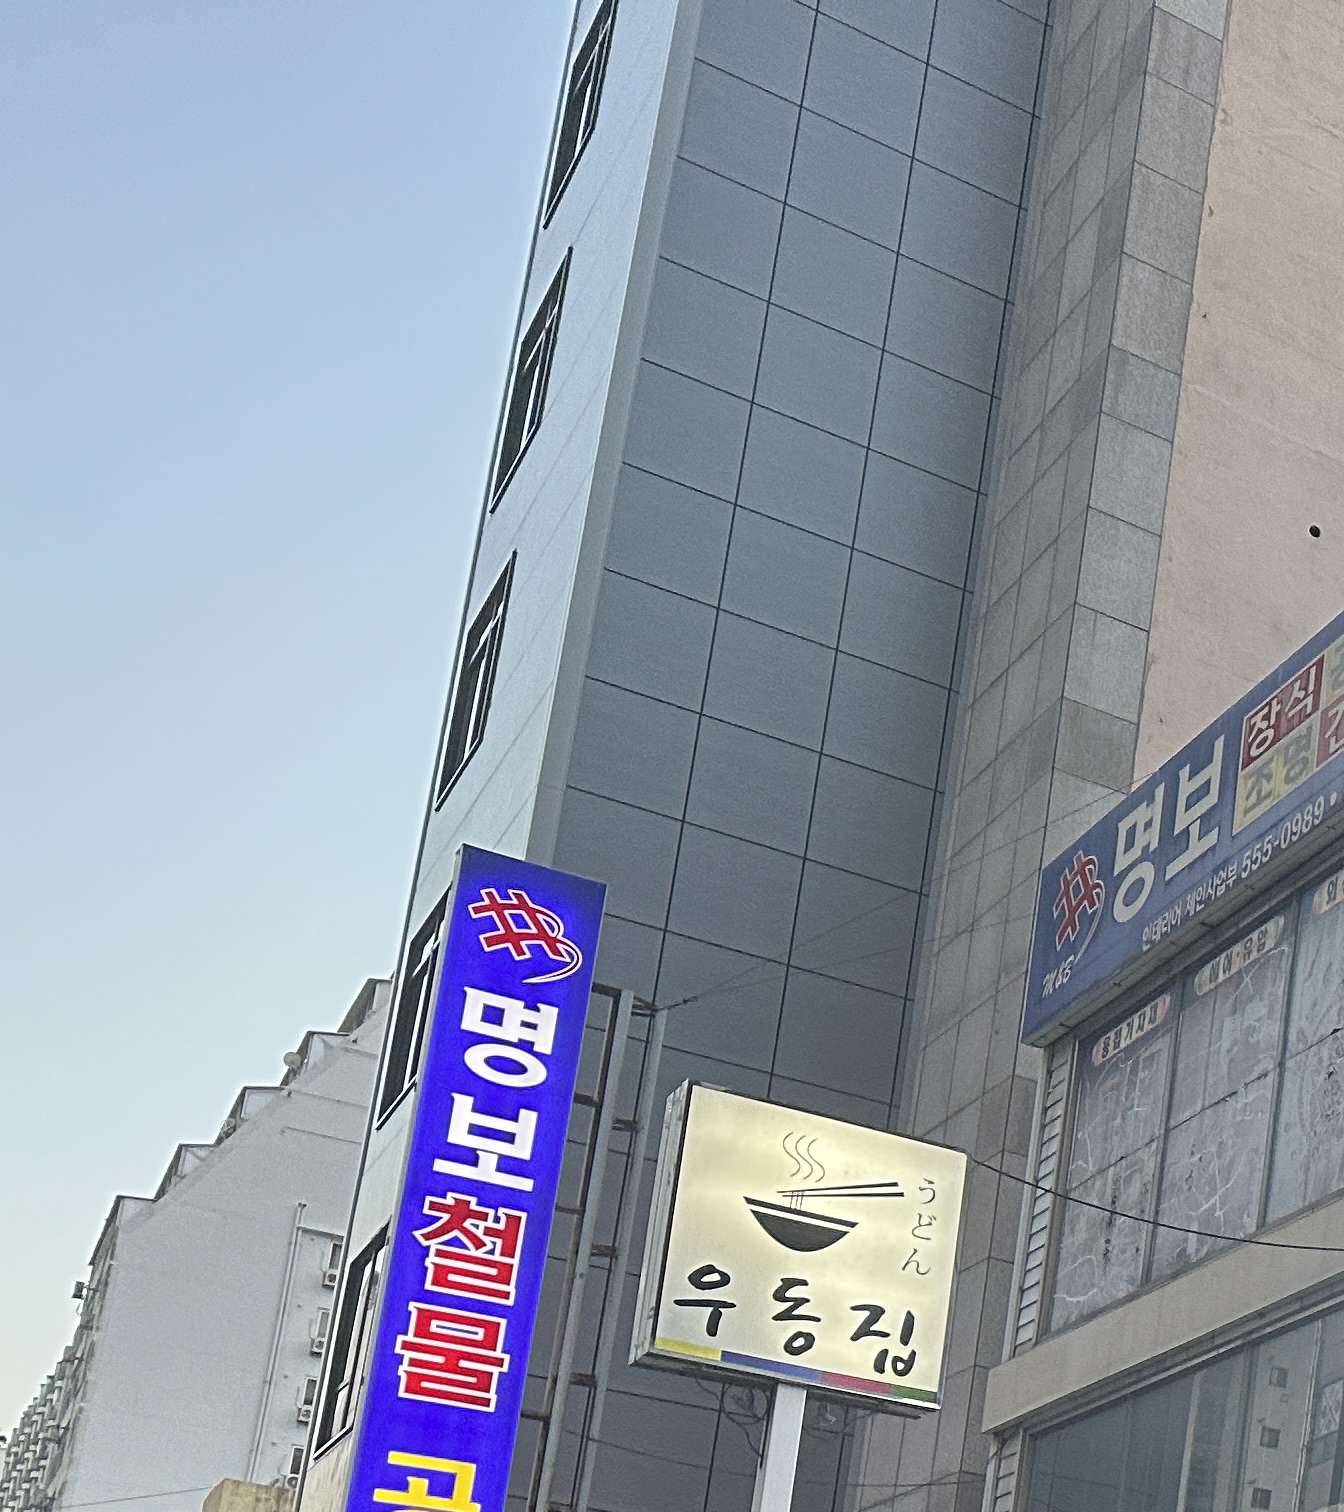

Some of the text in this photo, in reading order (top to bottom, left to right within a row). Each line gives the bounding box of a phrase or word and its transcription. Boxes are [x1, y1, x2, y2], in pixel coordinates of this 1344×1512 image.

[1247, 663, 1317, 758] 장식
[1243, 720, 1316, 820] 조명
[1112, 733, 1228, 925] 명보
[1141, 908, 1183, 952] 인테리어
[1239, 793, 1325, 881] 555-0989
[395, 984, 561, 1414] 명보철물
[901, 1177, 939, 1277] うどん
[673, 1263, 918, 1378] 우동집
